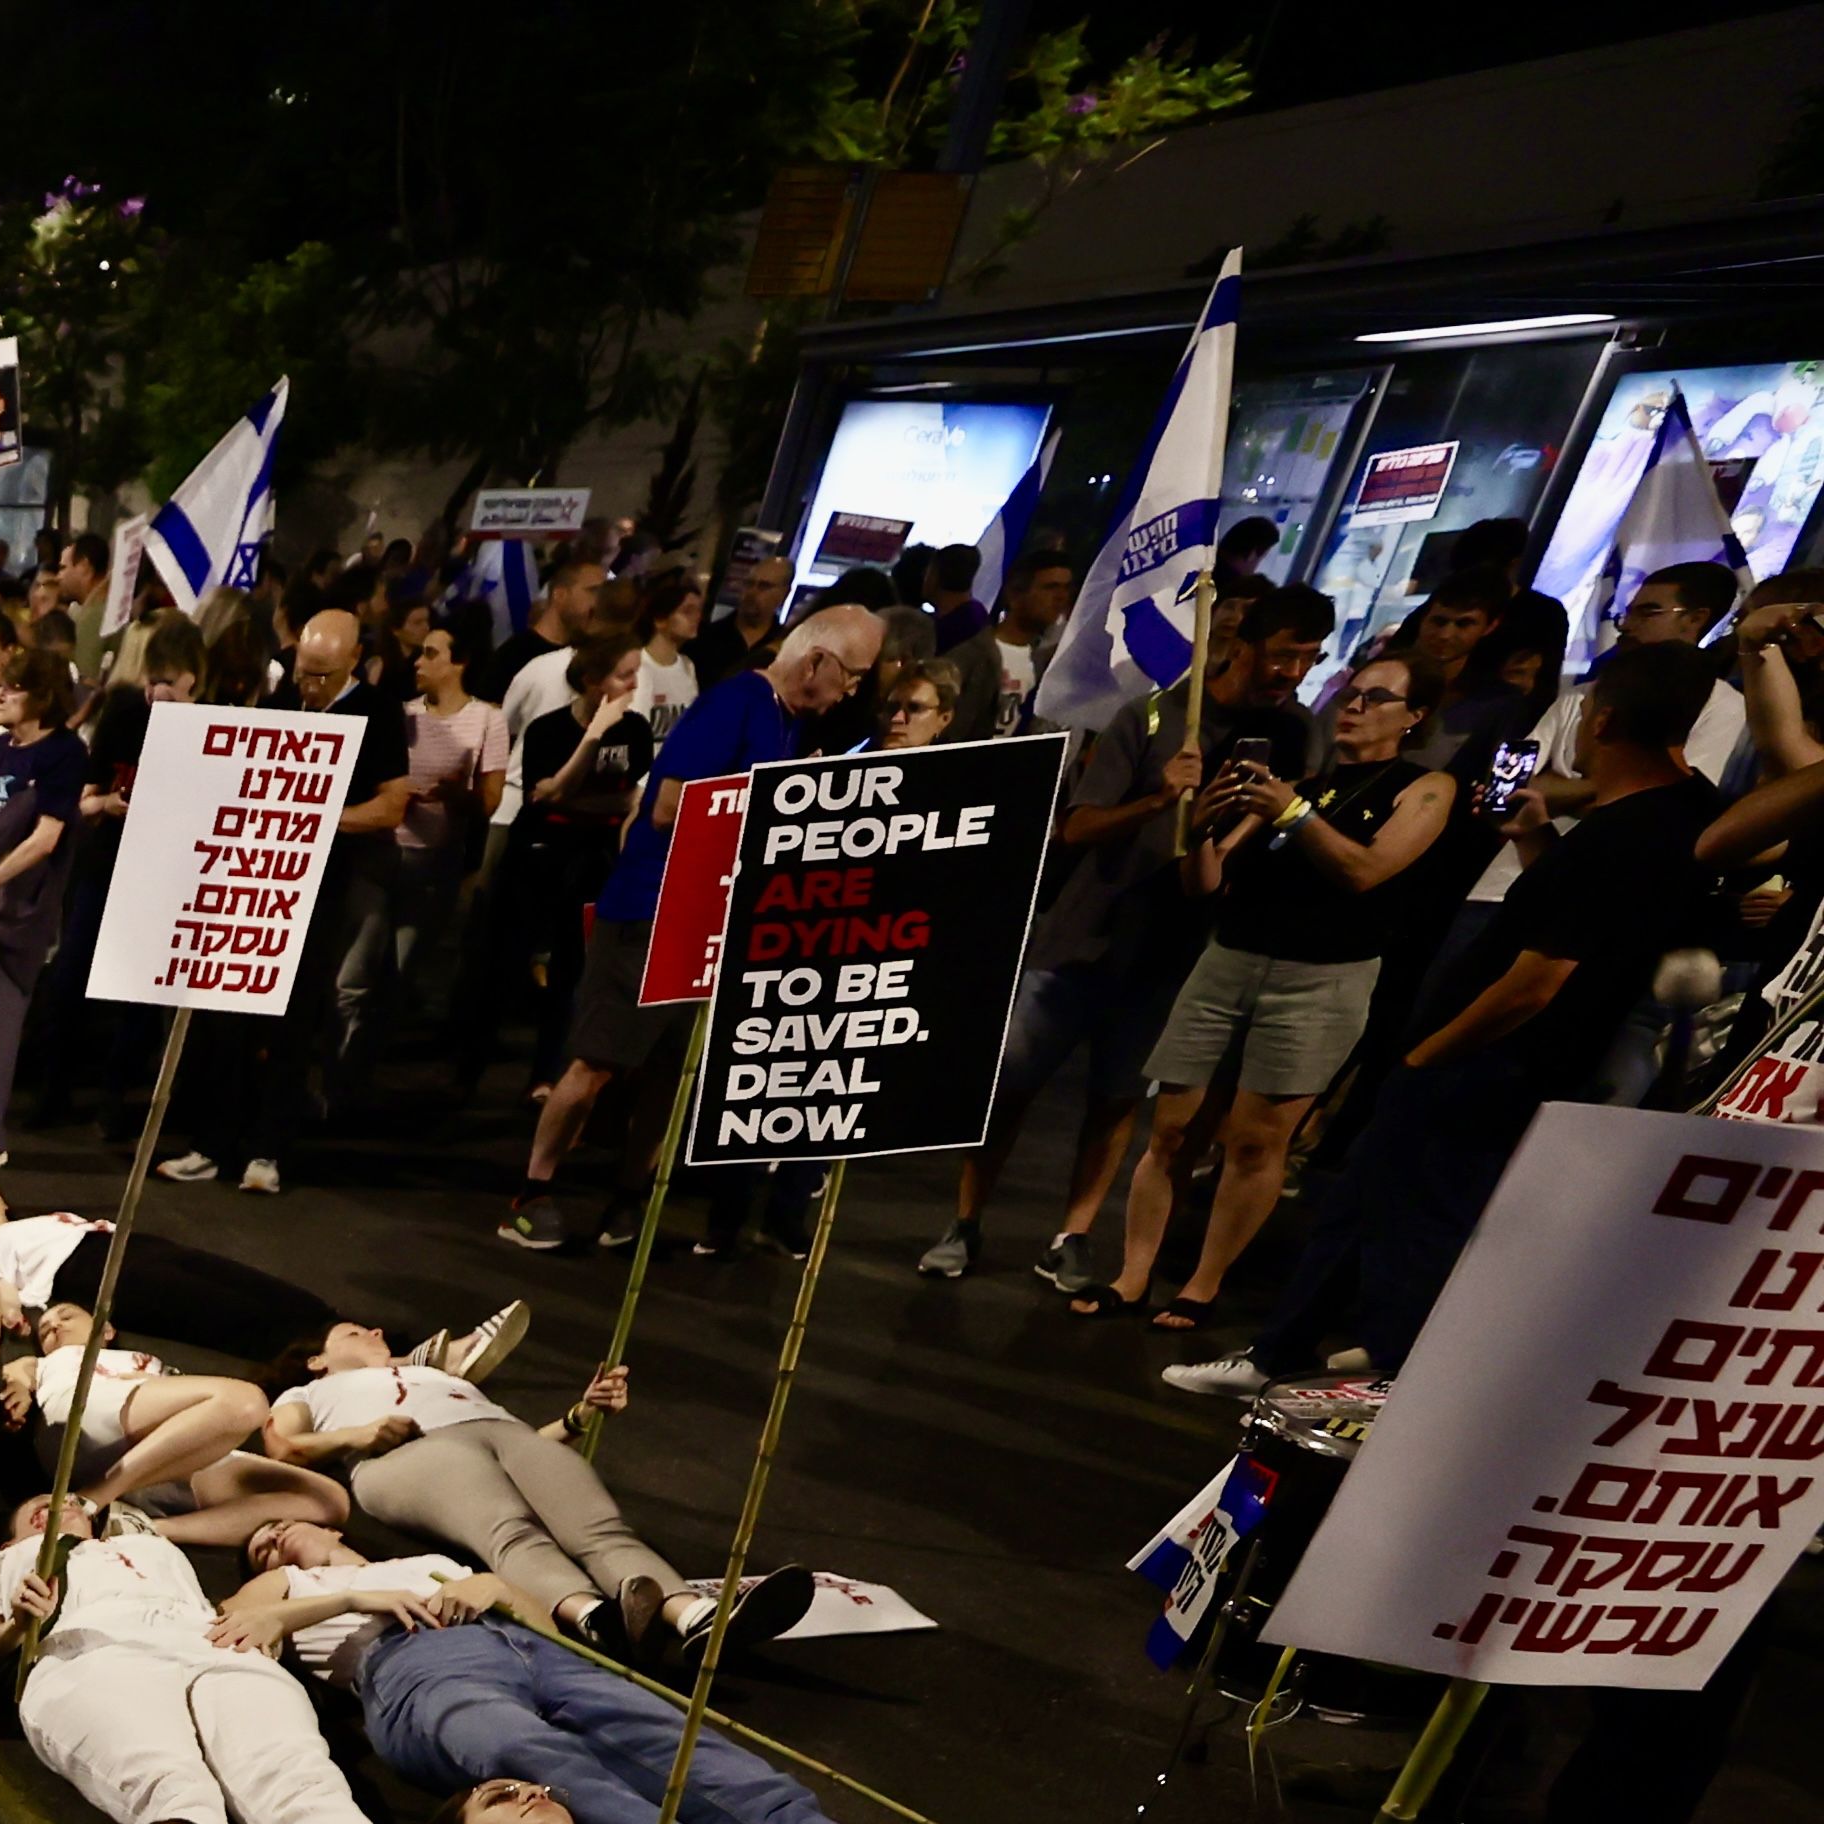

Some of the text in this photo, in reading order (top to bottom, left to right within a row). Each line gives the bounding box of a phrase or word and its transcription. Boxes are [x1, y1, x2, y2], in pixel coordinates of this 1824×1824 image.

[202, 724, 345, 765] האחים
[238, 767, 333, 804] שלנו
[773, 765, 904, 815] OUR
[212, 806, 322, 843] מתים
[763, 804, 996, 865] PEOPLE
[194, 840, 311, 881] שנציל
[182, 883, 301, 920] אותם.
[753, 867, 875, 913] ARE
[171, 919, 290, 957] עסקה
[747, 911, 932, 962] DYING
[154, 957, 280, 994] עכשיו.
[742, 959, 915, 1009] TO BE
[731, 1007, 931, 1055] SAVED.
[725, 1058, 881, 1101] DEAL
[717, 1103, 866, 1146] NOW.
[1532, 1462, 1813, 1529] אותם.
[1487, 1524, 1765, 1597] עסקה
[1431, 1592, 1719, 1656] עכשיו.
